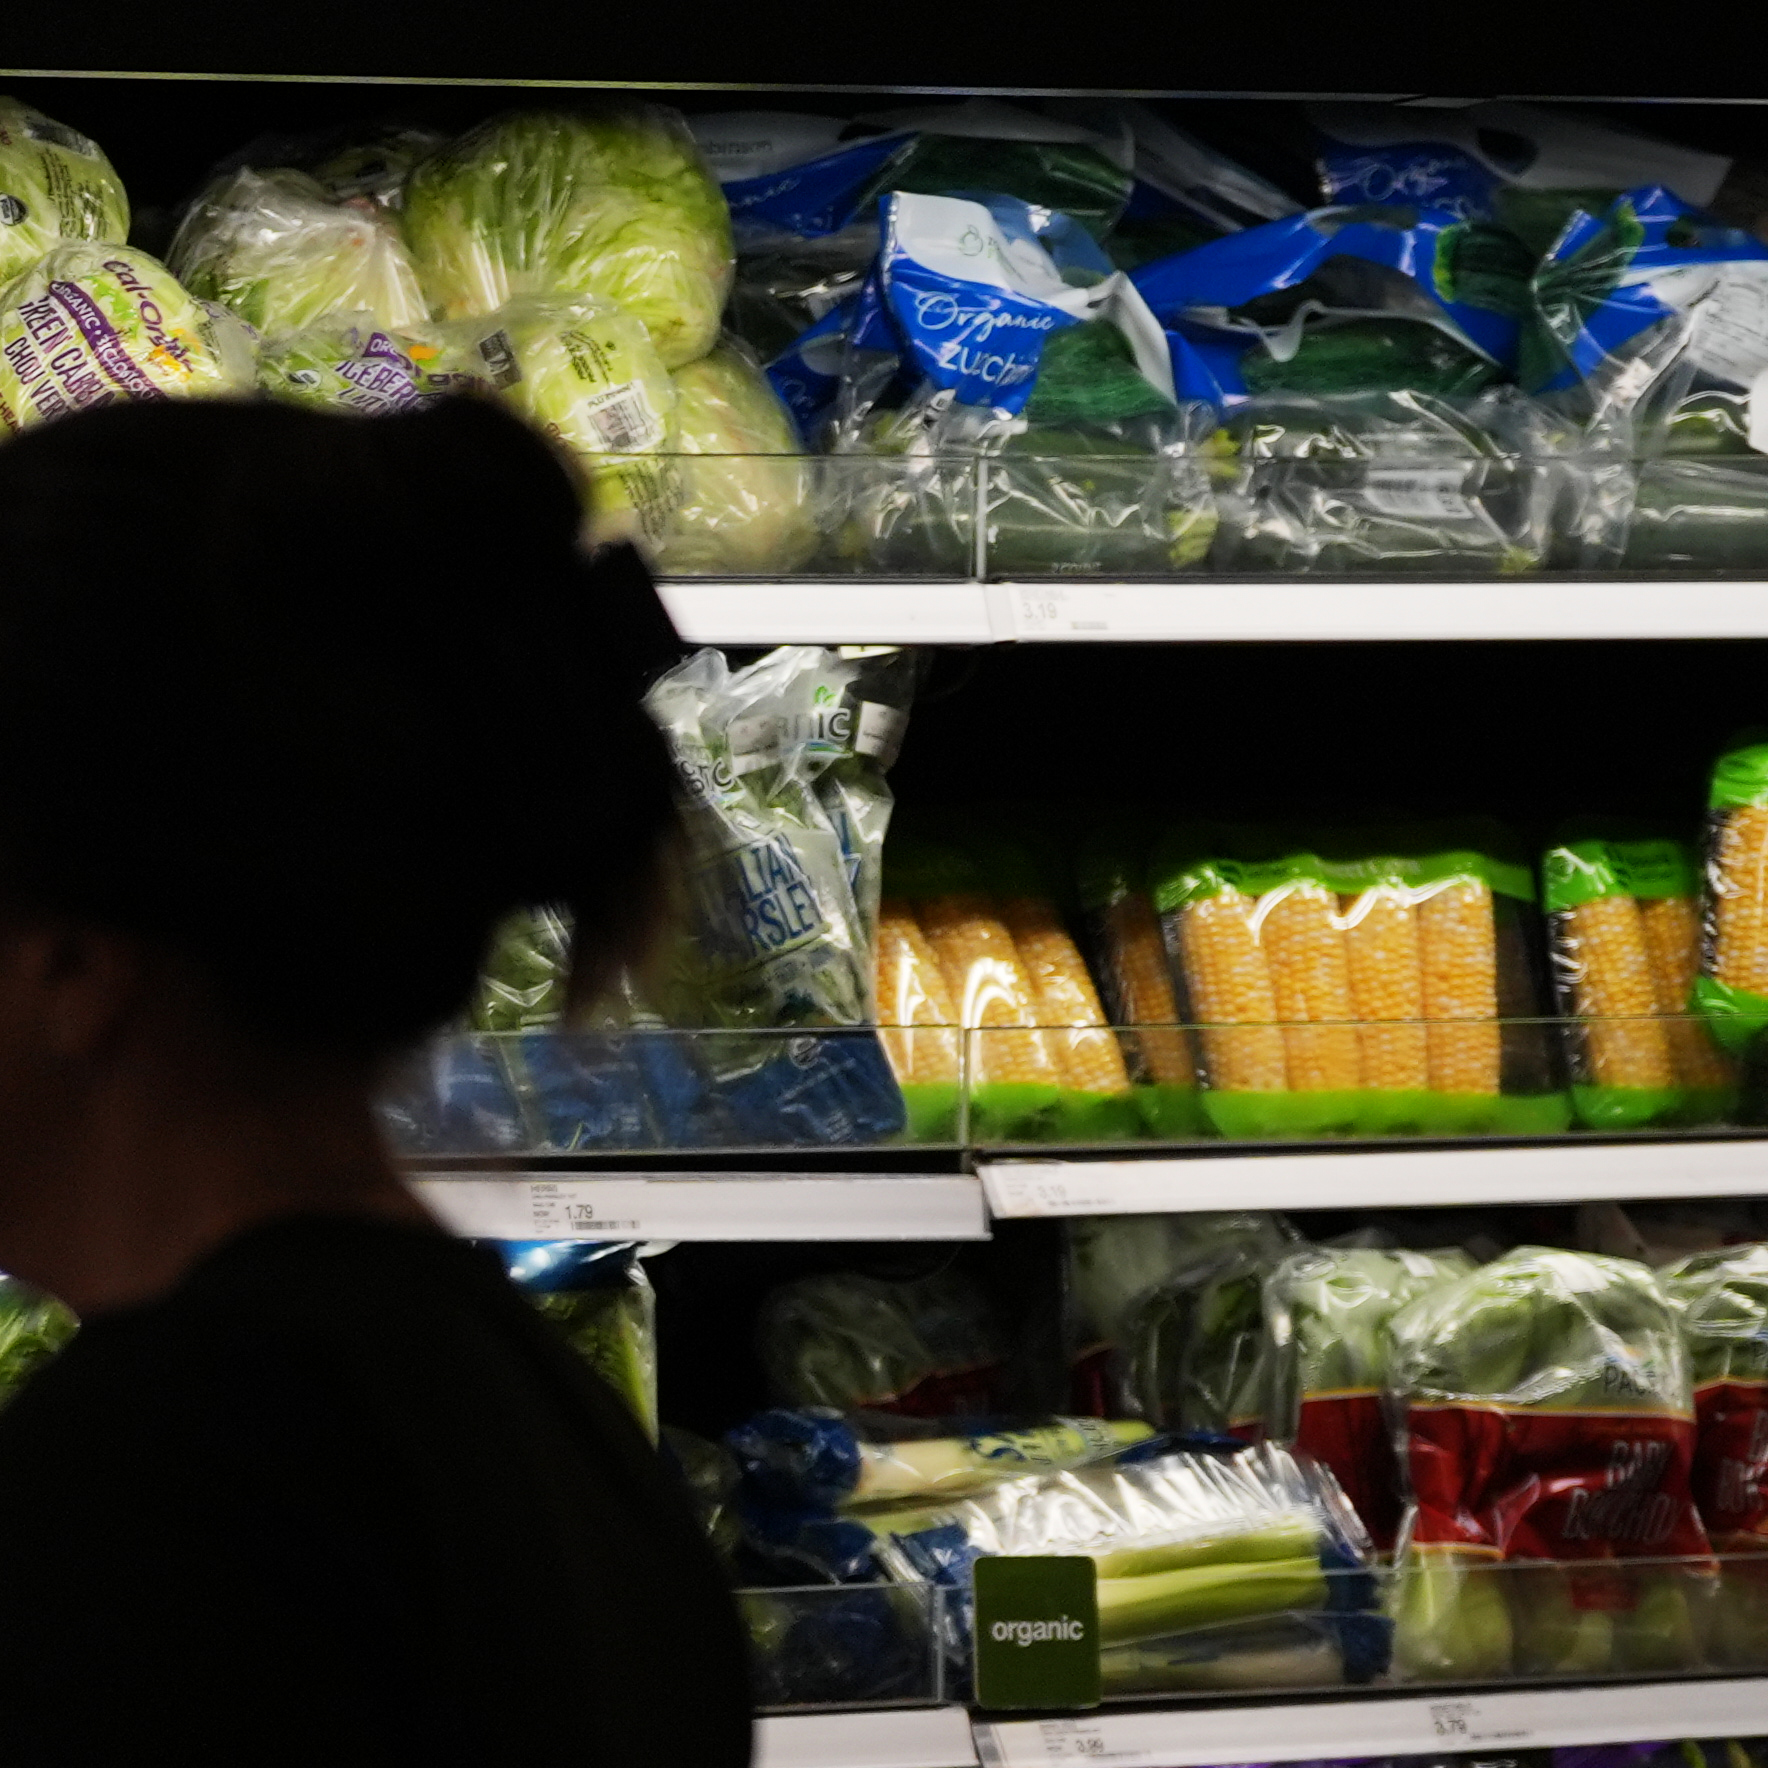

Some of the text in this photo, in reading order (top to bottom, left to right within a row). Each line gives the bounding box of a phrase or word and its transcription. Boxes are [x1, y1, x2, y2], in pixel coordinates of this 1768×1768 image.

[915, 291, 1054, 342] Organic
[565, 1204, 593, 1220] 1.79
[991, 1613, 1075, 1648] organic
